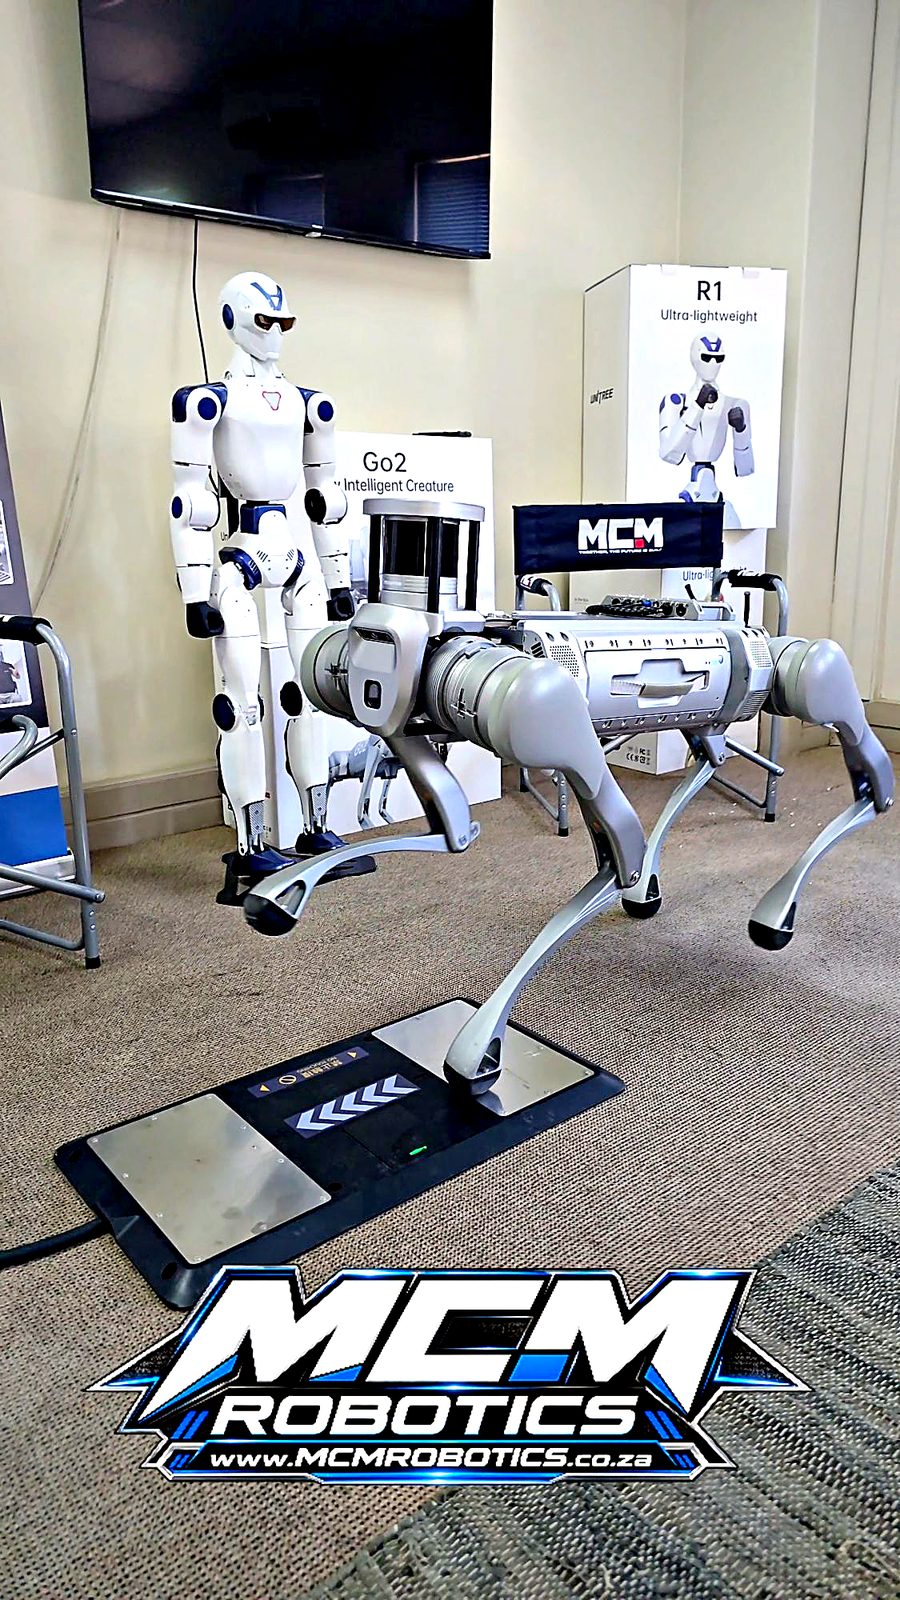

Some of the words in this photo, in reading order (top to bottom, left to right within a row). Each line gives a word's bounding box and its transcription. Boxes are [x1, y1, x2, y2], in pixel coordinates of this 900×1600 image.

[697, 280, 721, 301] R1
[660, 308, 758, 325] Ultra-lightweight
[363, 451, 407, 473] Go2
[343, 477, 404, 495] Intelligent
[405, 478, 455, 492] Creature
[578, 517, 664, 550] MCM
